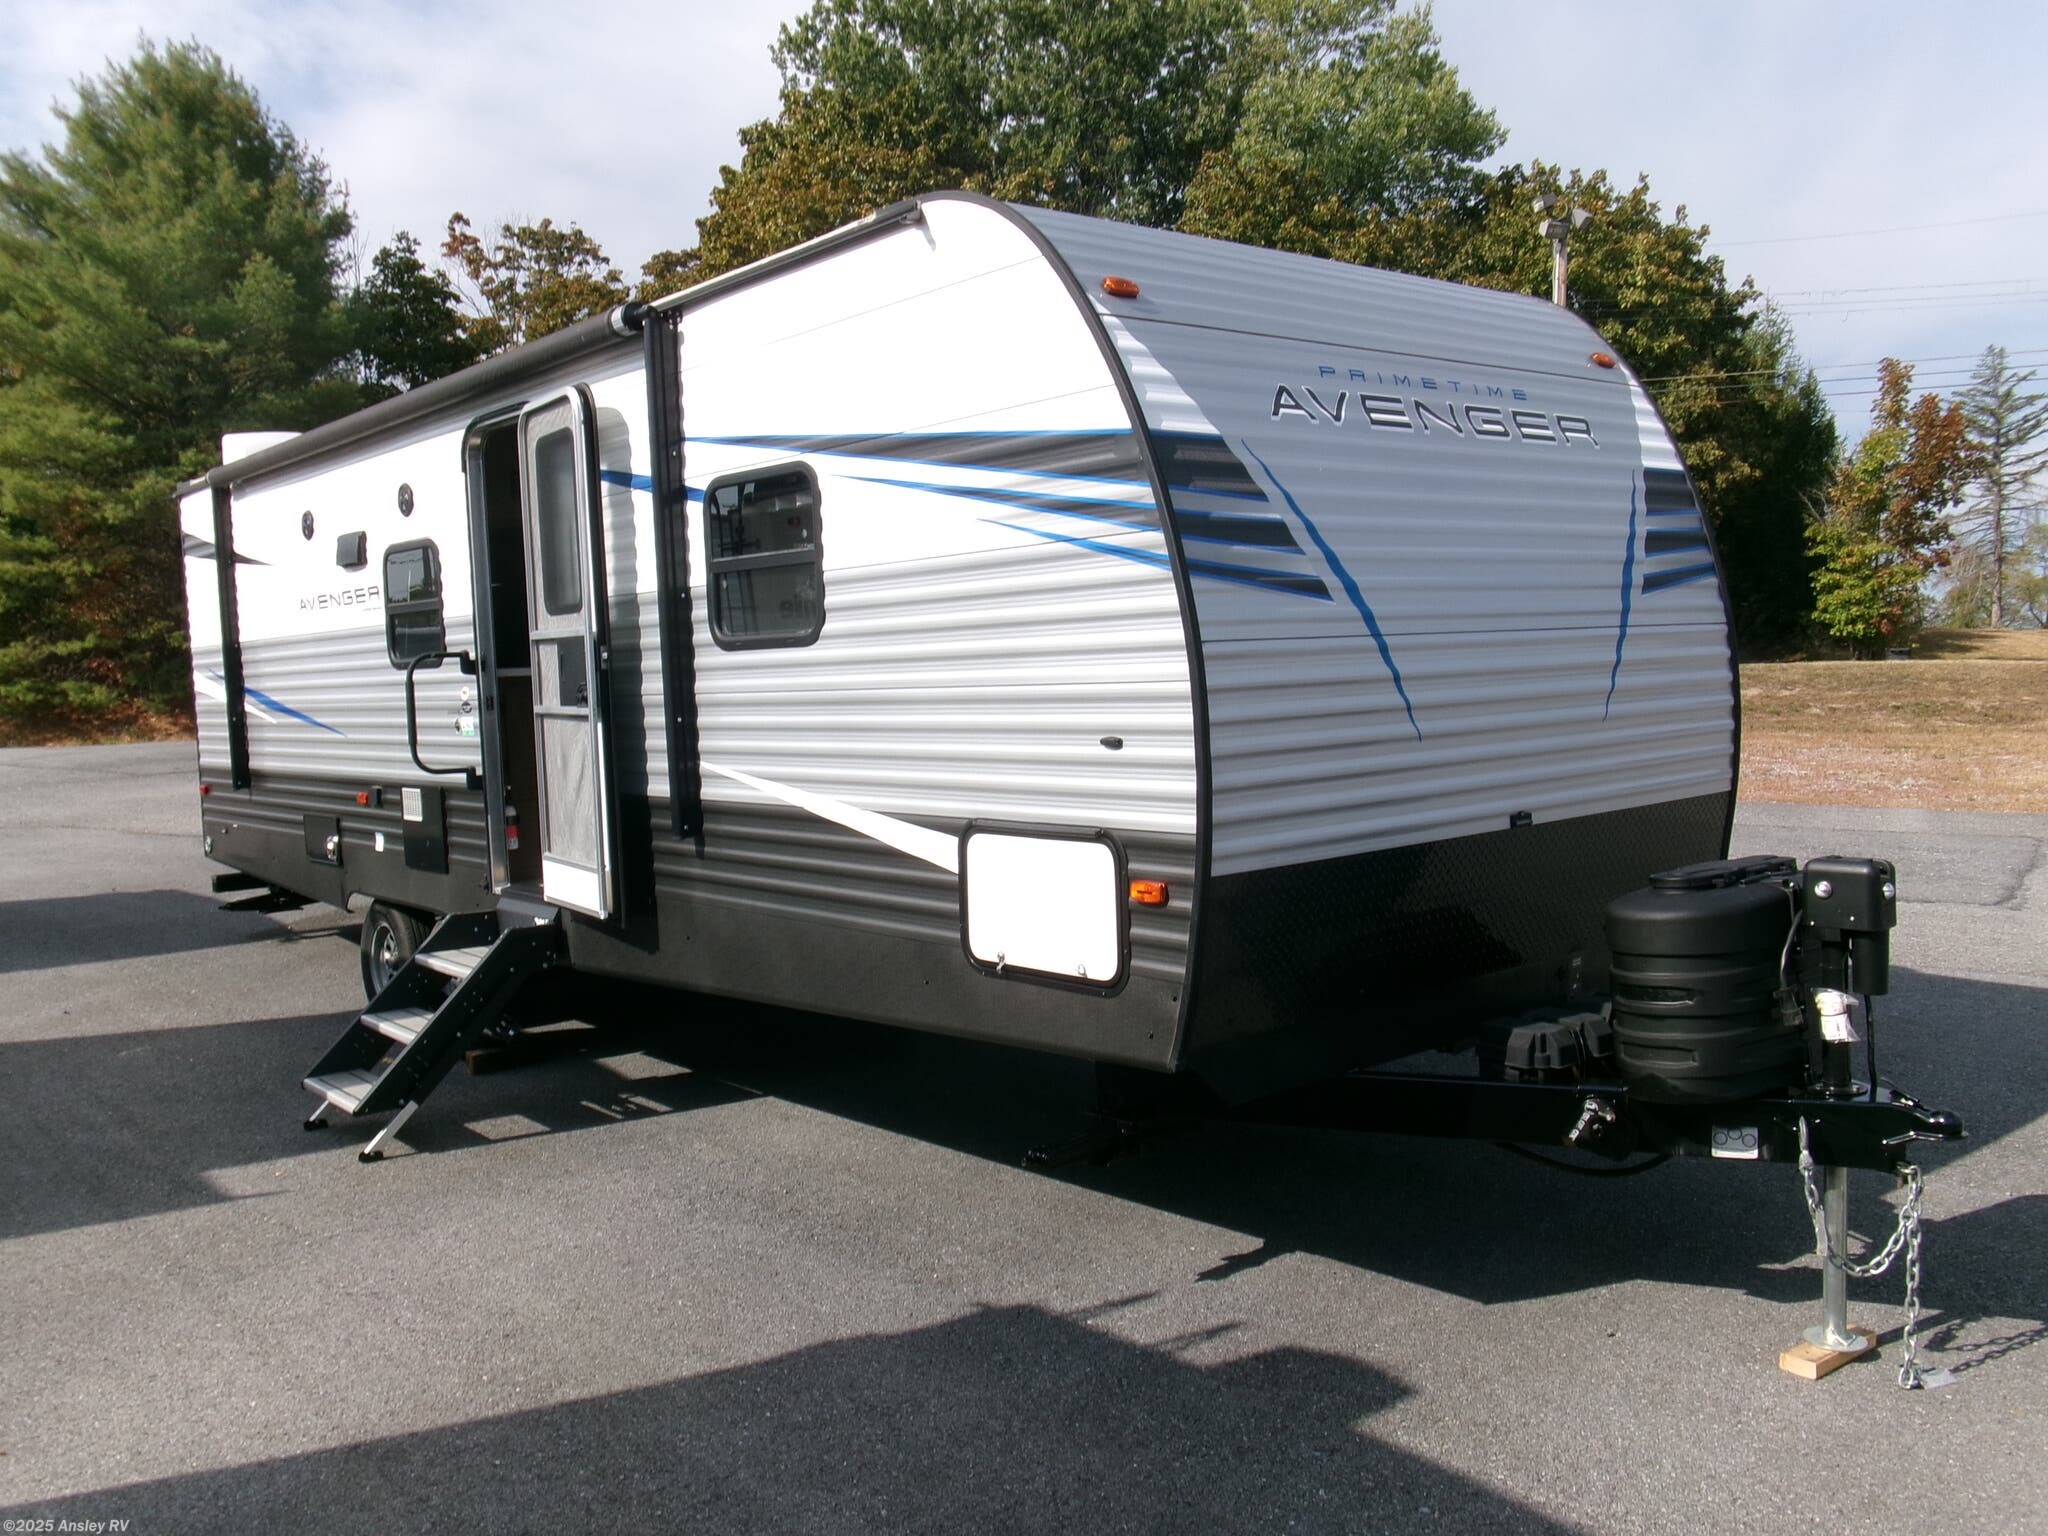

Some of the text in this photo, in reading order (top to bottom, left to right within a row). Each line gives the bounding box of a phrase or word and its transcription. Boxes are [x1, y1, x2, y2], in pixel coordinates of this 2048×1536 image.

[1318, 366, 1528, 400] PRIMETIME
[1271, 383, 1600, 448] AVENGER
[300, 586, 379, 610] AVENGER
